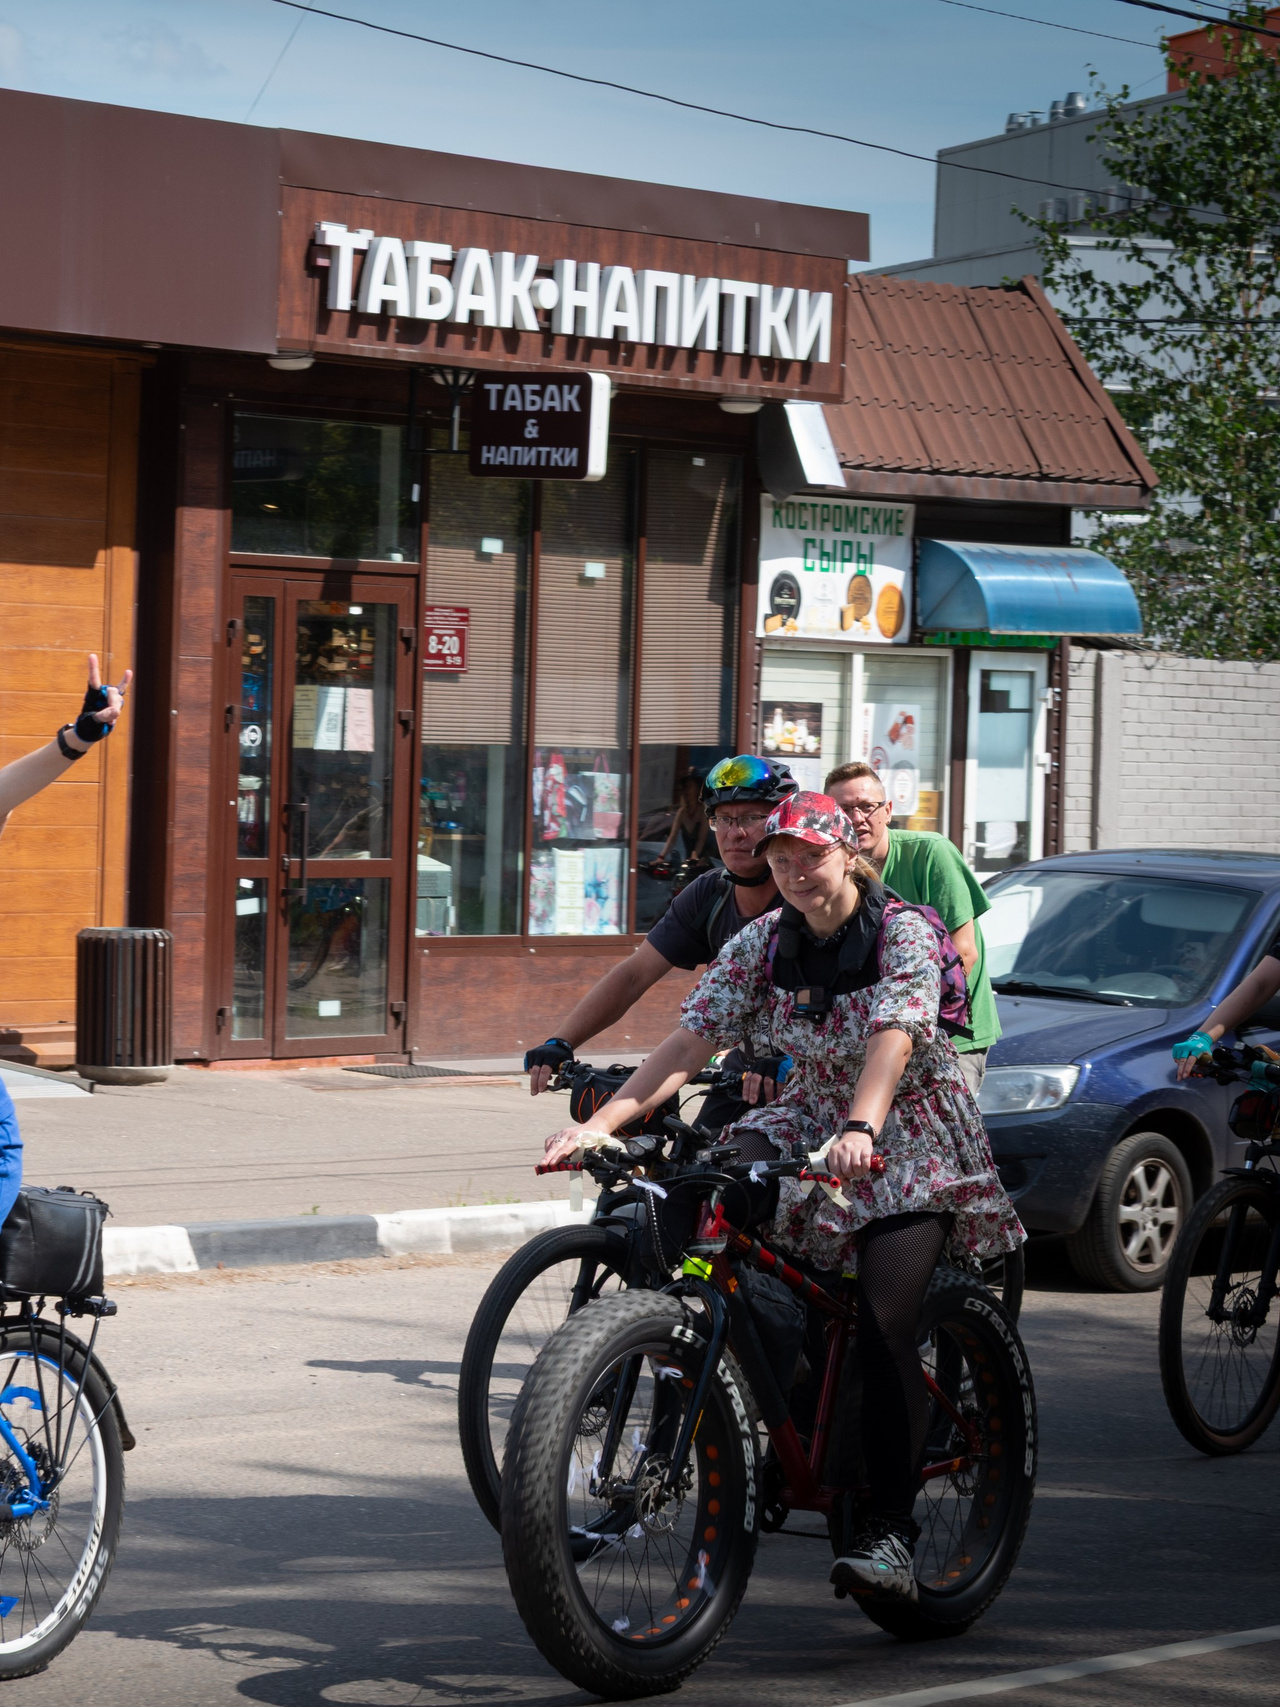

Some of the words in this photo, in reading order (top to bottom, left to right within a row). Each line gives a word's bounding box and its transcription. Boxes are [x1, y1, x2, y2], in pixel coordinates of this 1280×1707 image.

[316, 221, 541, 331] ТАБАК
[552, 258, 833, 364] НАПИТКИ
[483, 383, 582, 412] ТАБАК
[523, 418, 540, 439] &
[480, 445, 579, 467] НАПИТКИ
[772, 501, 905, 537] КОСТРОМСКИЕ
[803, 537, 875, 576] СЫРЫ
[428, 635, 460, 654] 8-20
[726, 1385, 752, 1436] POLY
